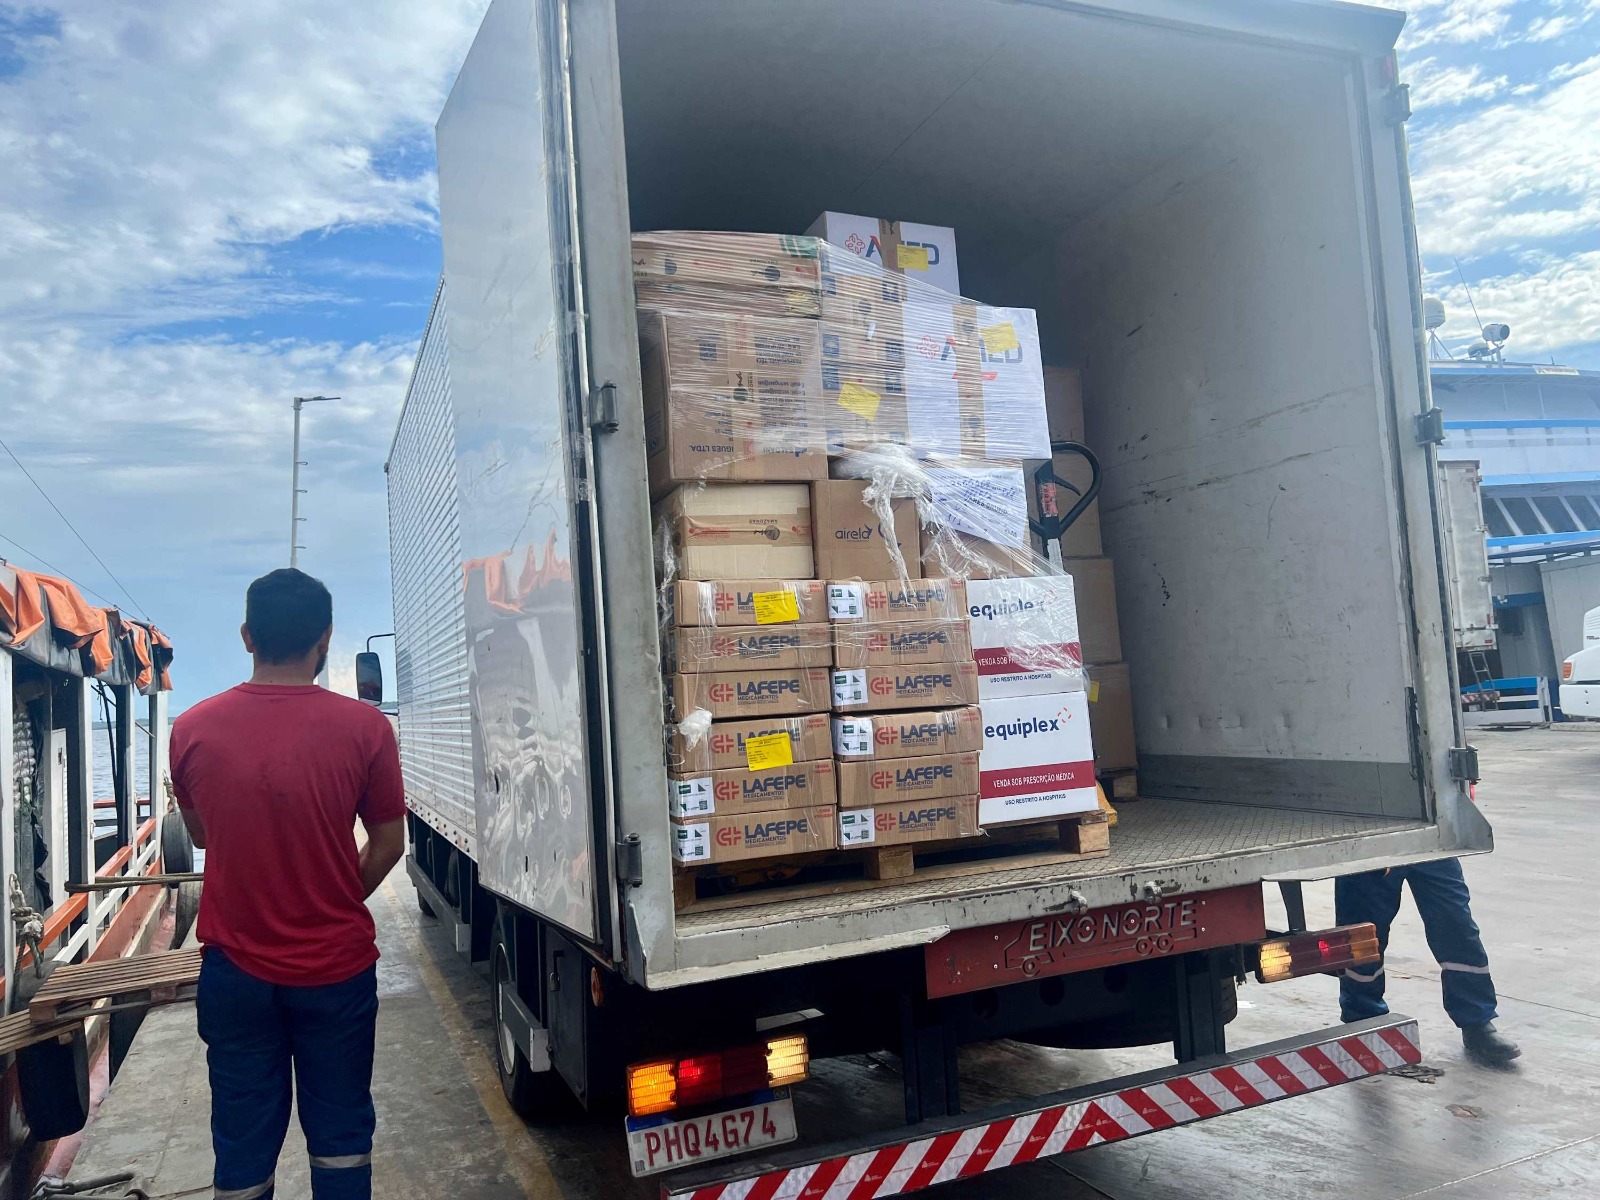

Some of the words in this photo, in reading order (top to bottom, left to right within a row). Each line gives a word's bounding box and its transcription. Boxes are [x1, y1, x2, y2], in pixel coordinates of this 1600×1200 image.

[711, 445, 734, 453] IGUES
[889, 589, 945, 603] LAFEPE
[738, 635, 800, 651] LAFEPE
[890, 630, 947, 646] LAFEPE
[996, 656, 1008, 665] SOB
[737, 680, 800, 696] LAFEPE
[895, 674, 952, 690] LAFEPE
[896, 687, 933, 695] MEDICAMENTOS
[900, 721, 957, 739] LAFEPE
[984, 717, 1059, 740] equiplex
[896, 764, 953, 782] LAFEPE
[993, 779, 1011, 789] VENDA
[1011, 778, 1023, 786] SOB
[1023, 773, 1055, 785] PRESCRIÇÃO
[1056, 771, 1075, 781] MÉDICA
[743, 774, 806, 794] LAFEPE
[896, 780, 934, 788] MEDICAMENTOS
[743, 791, 785, 799] MEDICAMENTOS
[898, 806, 956, 825] LAFEPE
[744, 818, 808, 839] LAFEPE
[745, 836, 787, 844] MEDICAMENTOS
[1030, 916, 1097, 951] EIXO
[1101, 900, 1198, 940] NORTE
[644, 1106, 777, 1167] PHQ4G74
